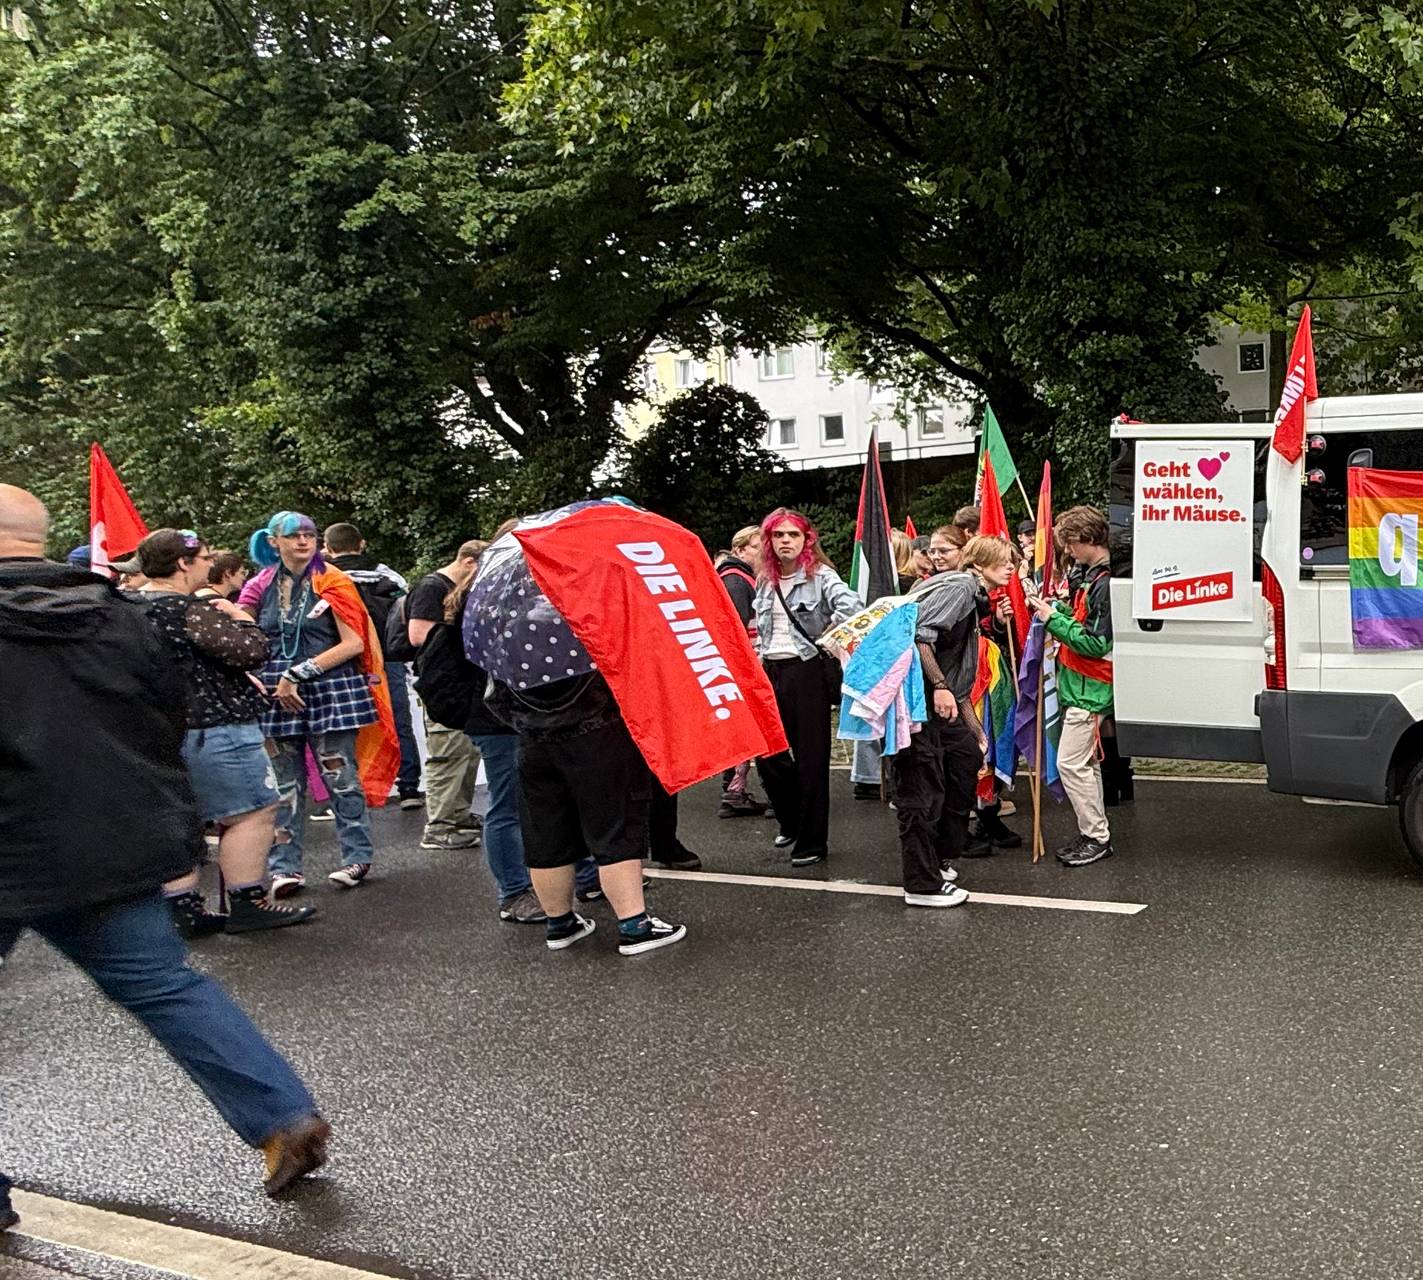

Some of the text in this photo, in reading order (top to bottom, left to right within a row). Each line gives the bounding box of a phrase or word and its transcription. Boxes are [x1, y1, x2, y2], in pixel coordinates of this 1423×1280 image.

[1143, 461, 1191, 478] Geht
[1142, 482, 1224, 503] wählen,
[1142, 504, 1247, 522] ihr Mäuse.
[1158, 579, 1229, 605] Die Linke
[616, 541, 745, 720] DIE LINKE.
